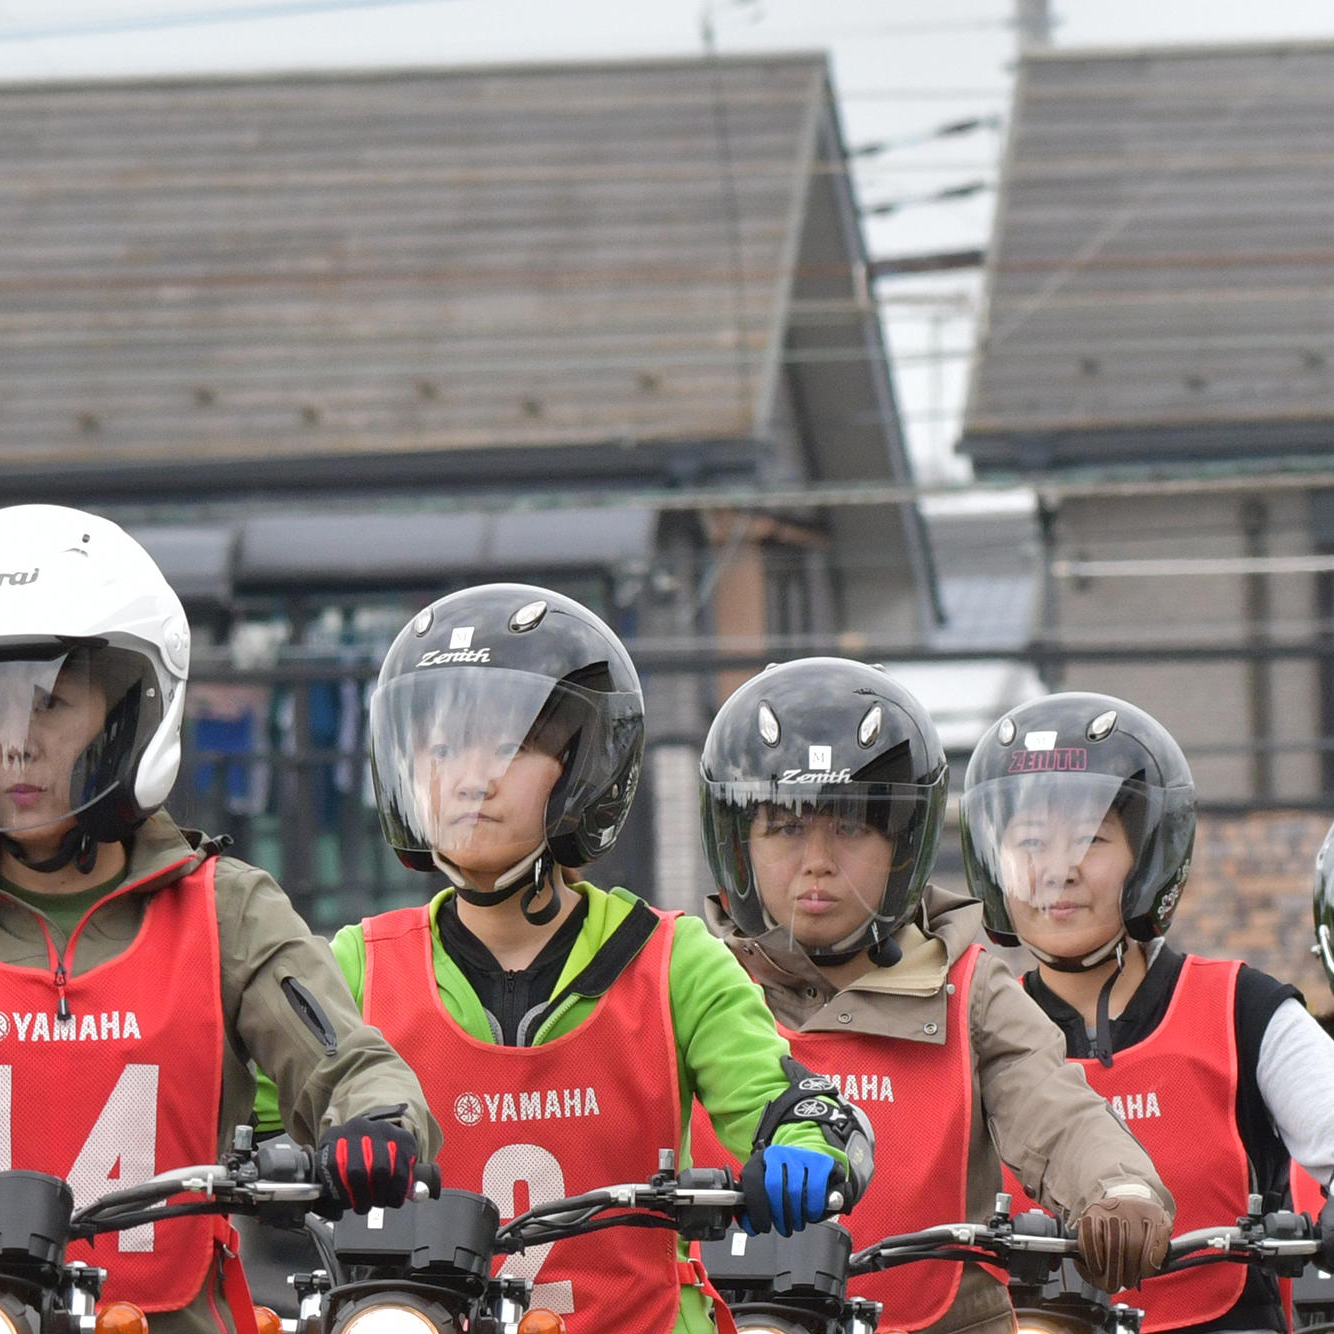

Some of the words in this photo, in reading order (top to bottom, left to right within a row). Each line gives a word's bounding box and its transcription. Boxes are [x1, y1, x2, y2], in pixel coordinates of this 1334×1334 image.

[415, 647, 491, 668] Zenith
[1008, 747, 1087, 773] ZENITH
[777, 768, 853, 785] Zenith
[12, 1010, 142, 1042] YAMAHA
[817, 1074, 895, 1103] MAHA
[483, 1086, 600, 1123] YAMAHA
[481, 1142, 576, 1315] 2
